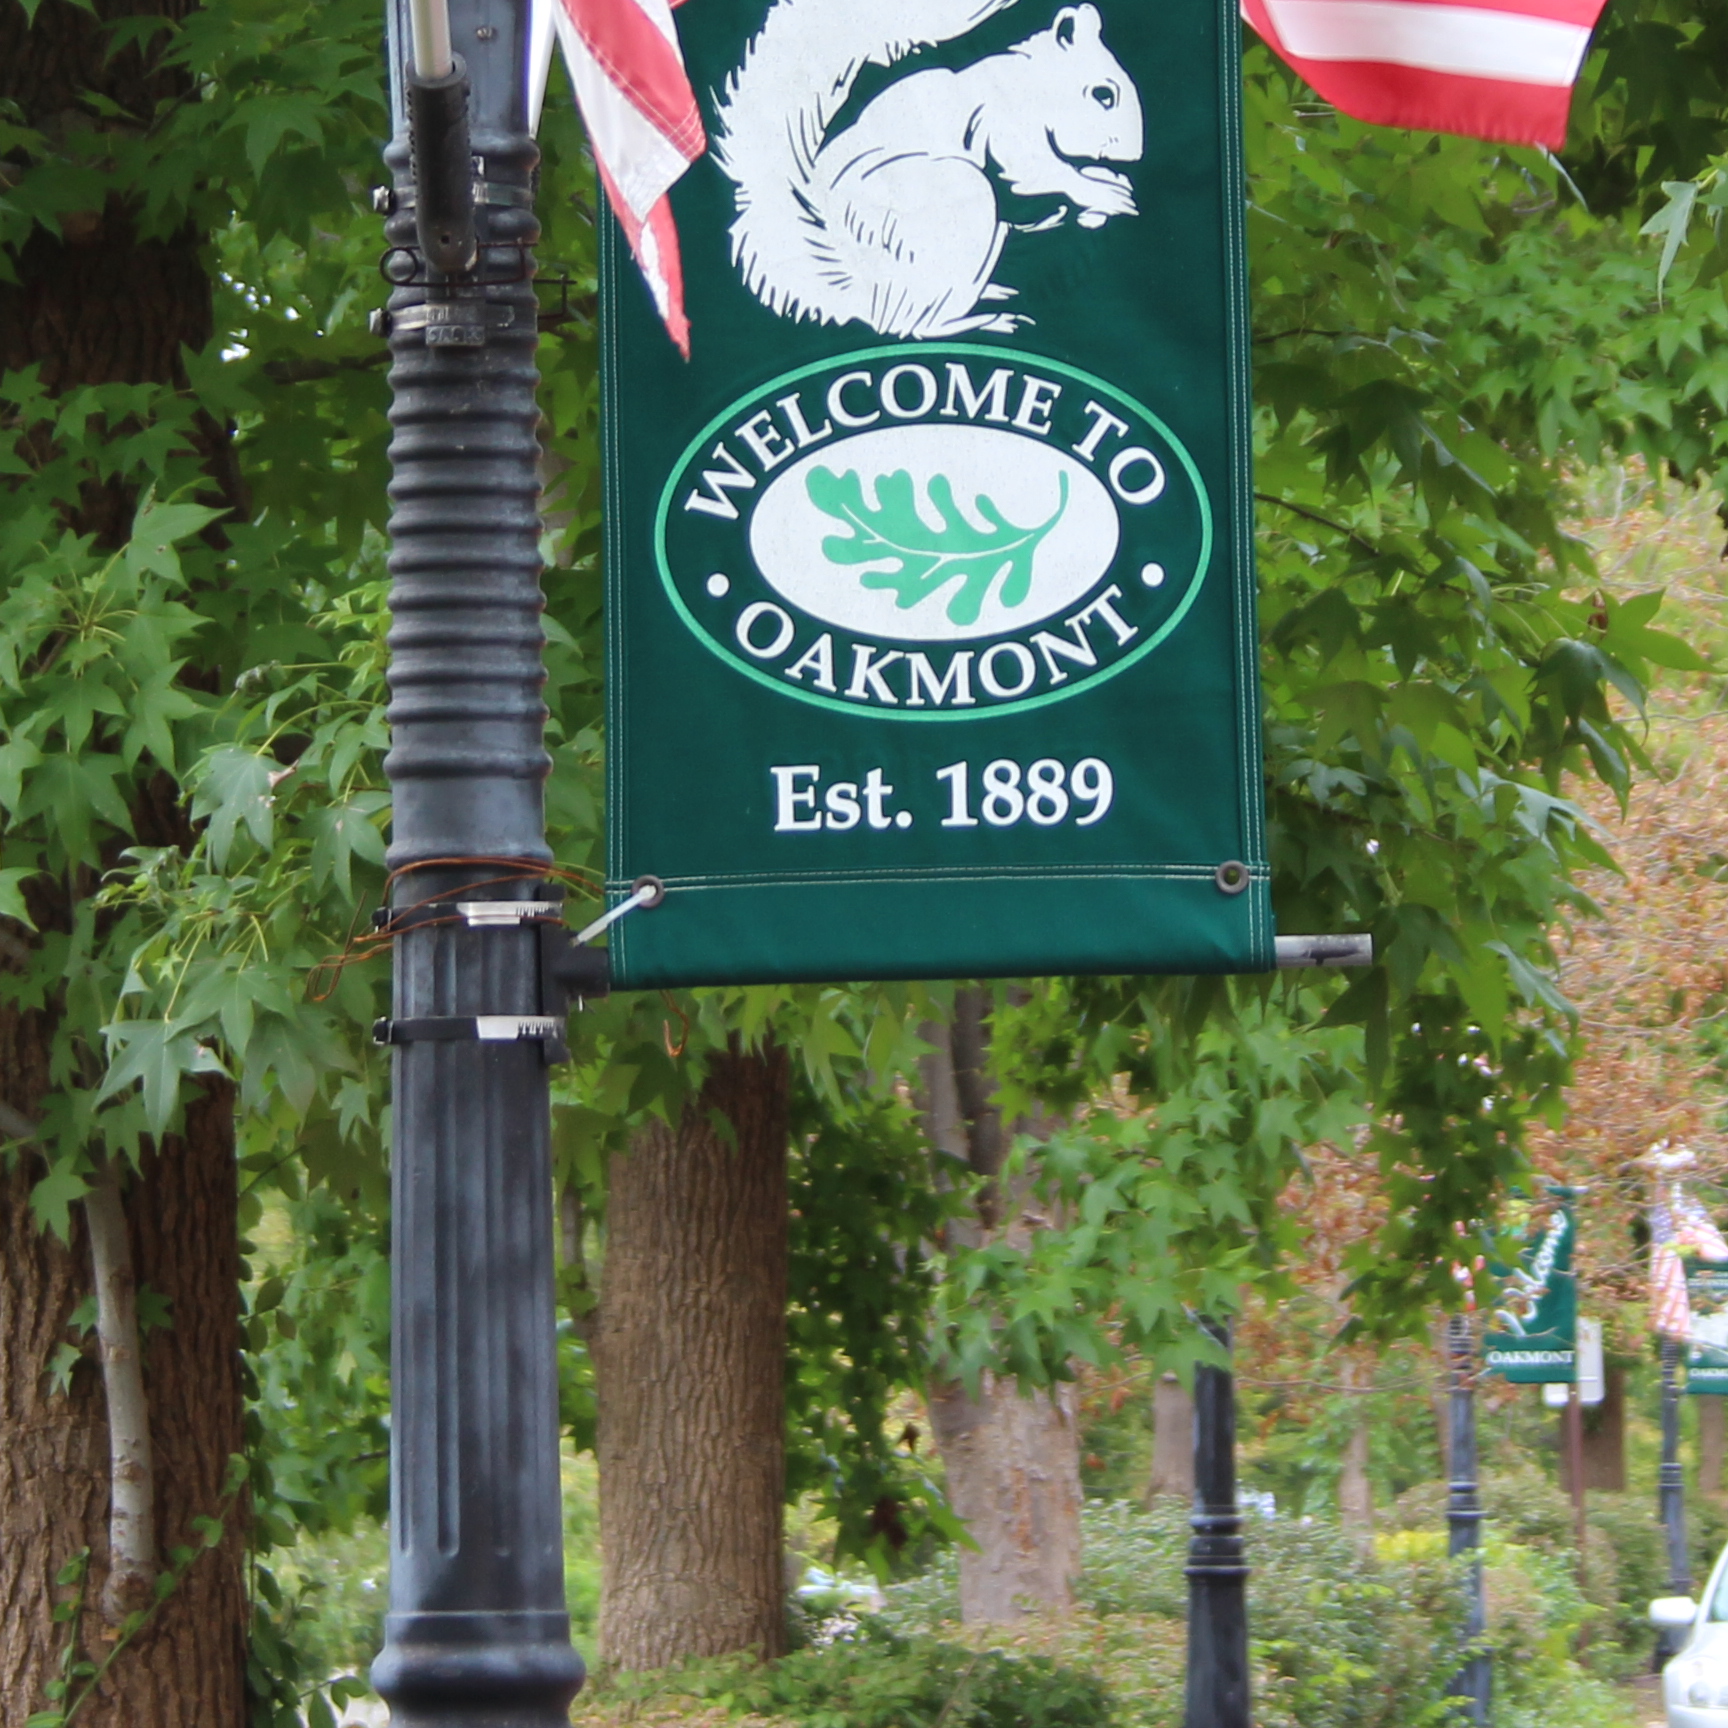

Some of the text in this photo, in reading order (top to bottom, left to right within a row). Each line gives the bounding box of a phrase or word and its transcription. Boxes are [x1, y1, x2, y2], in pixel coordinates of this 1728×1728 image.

[683, 361, 1166, 521] WELCOME TO
[734, 584, 1140, 707] OAKMONT
[770, 757, 1115, 832] Est. 1889
[1486, 1350, 1576, 1364] OAKMONT
